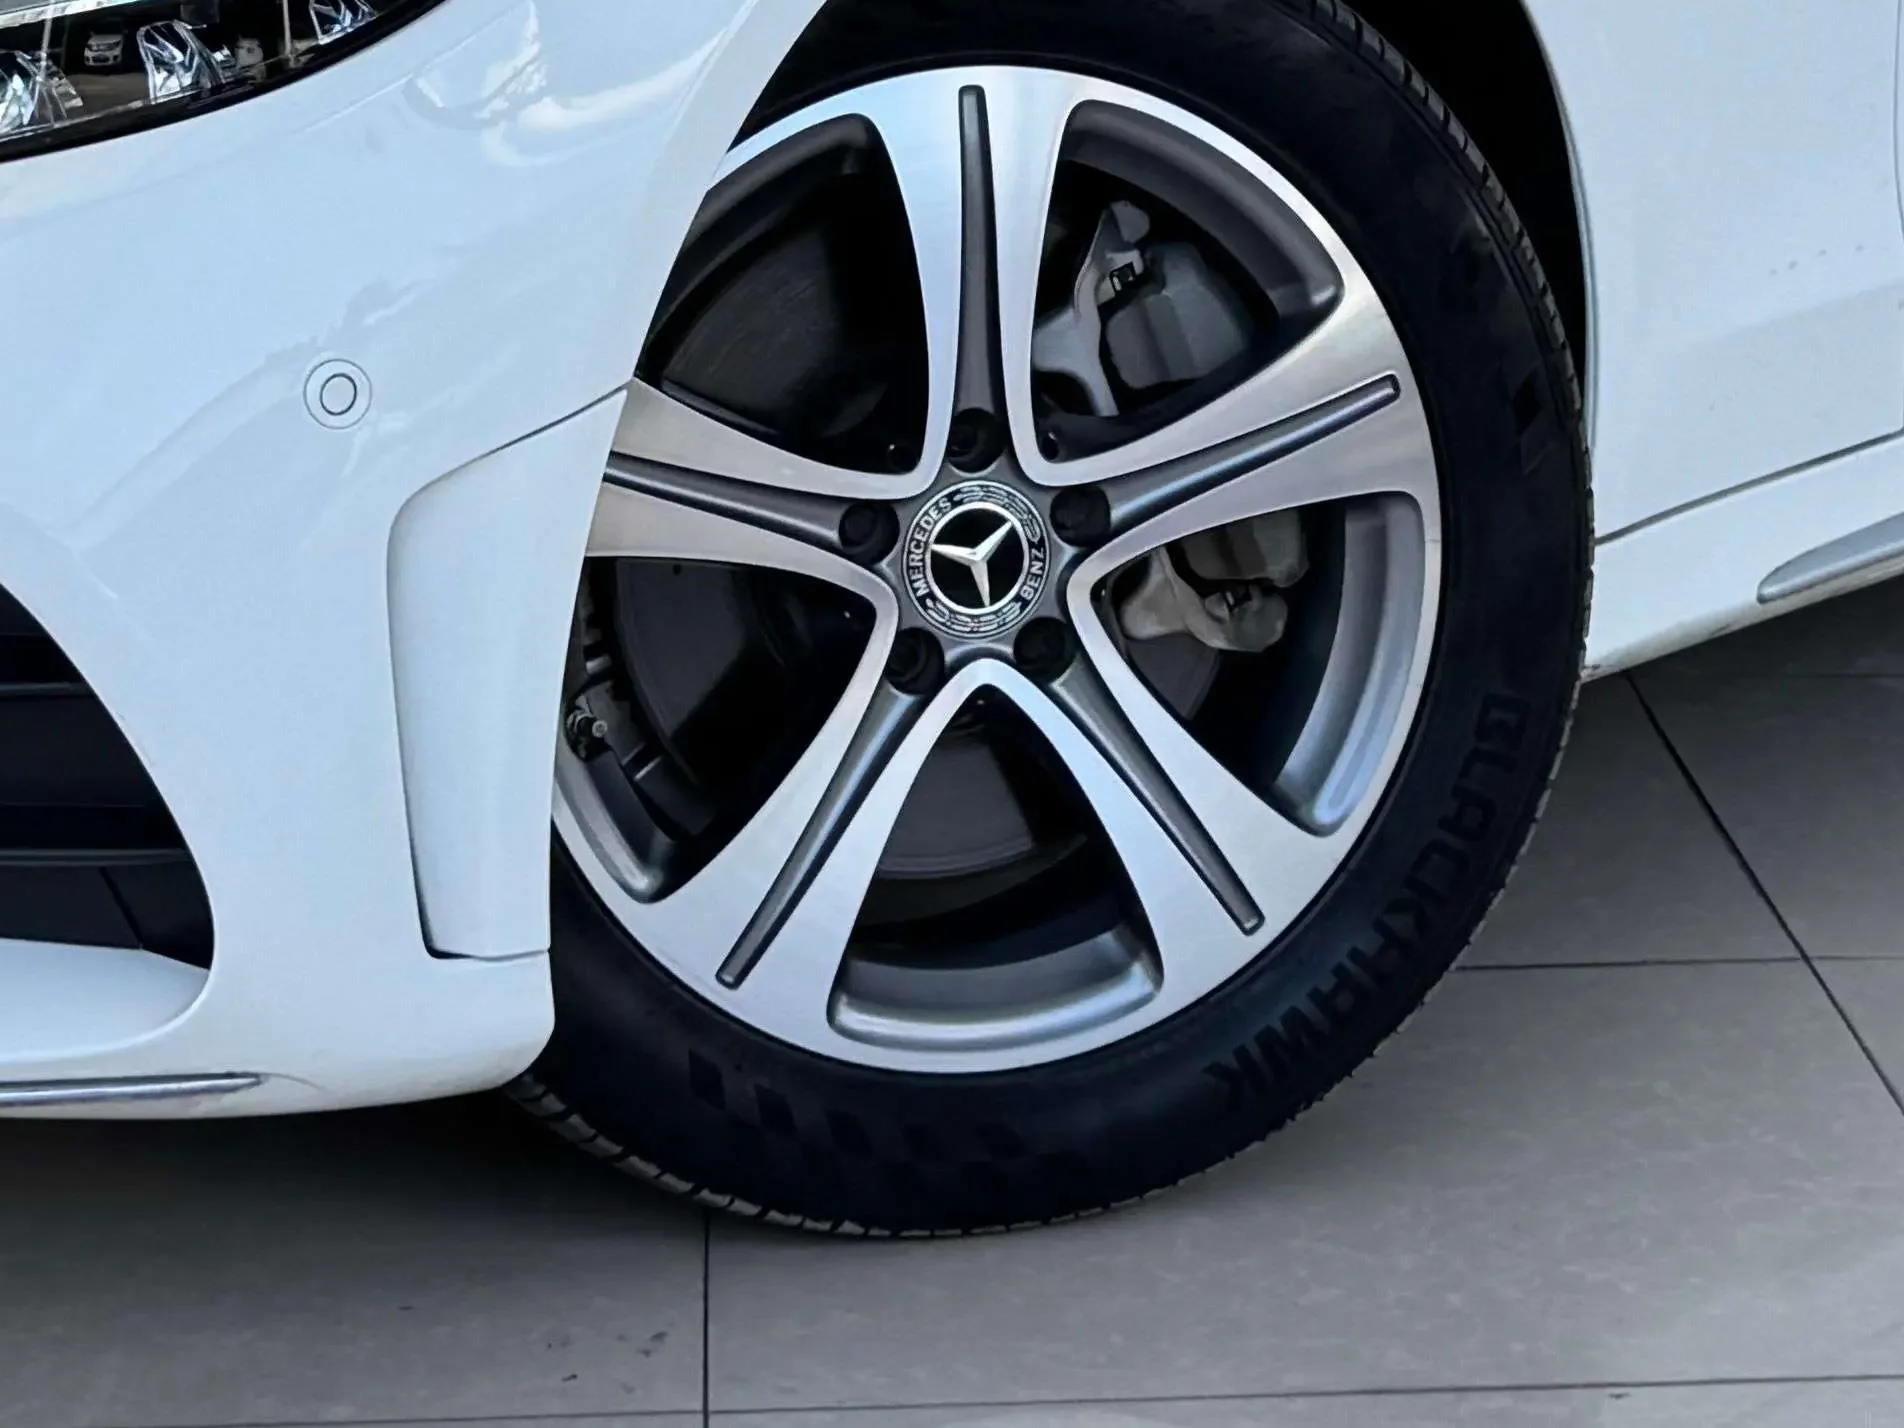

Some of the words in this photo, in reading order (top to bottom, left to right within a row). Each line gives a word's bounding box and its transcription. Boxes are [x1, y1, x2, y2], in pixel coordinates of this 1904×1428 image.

[908, 497, 950, 596] MERCEDES
[1021, 547, 1045, 600] BENZ
[1203, 693, 1531, 1112] BLACKHAWK
